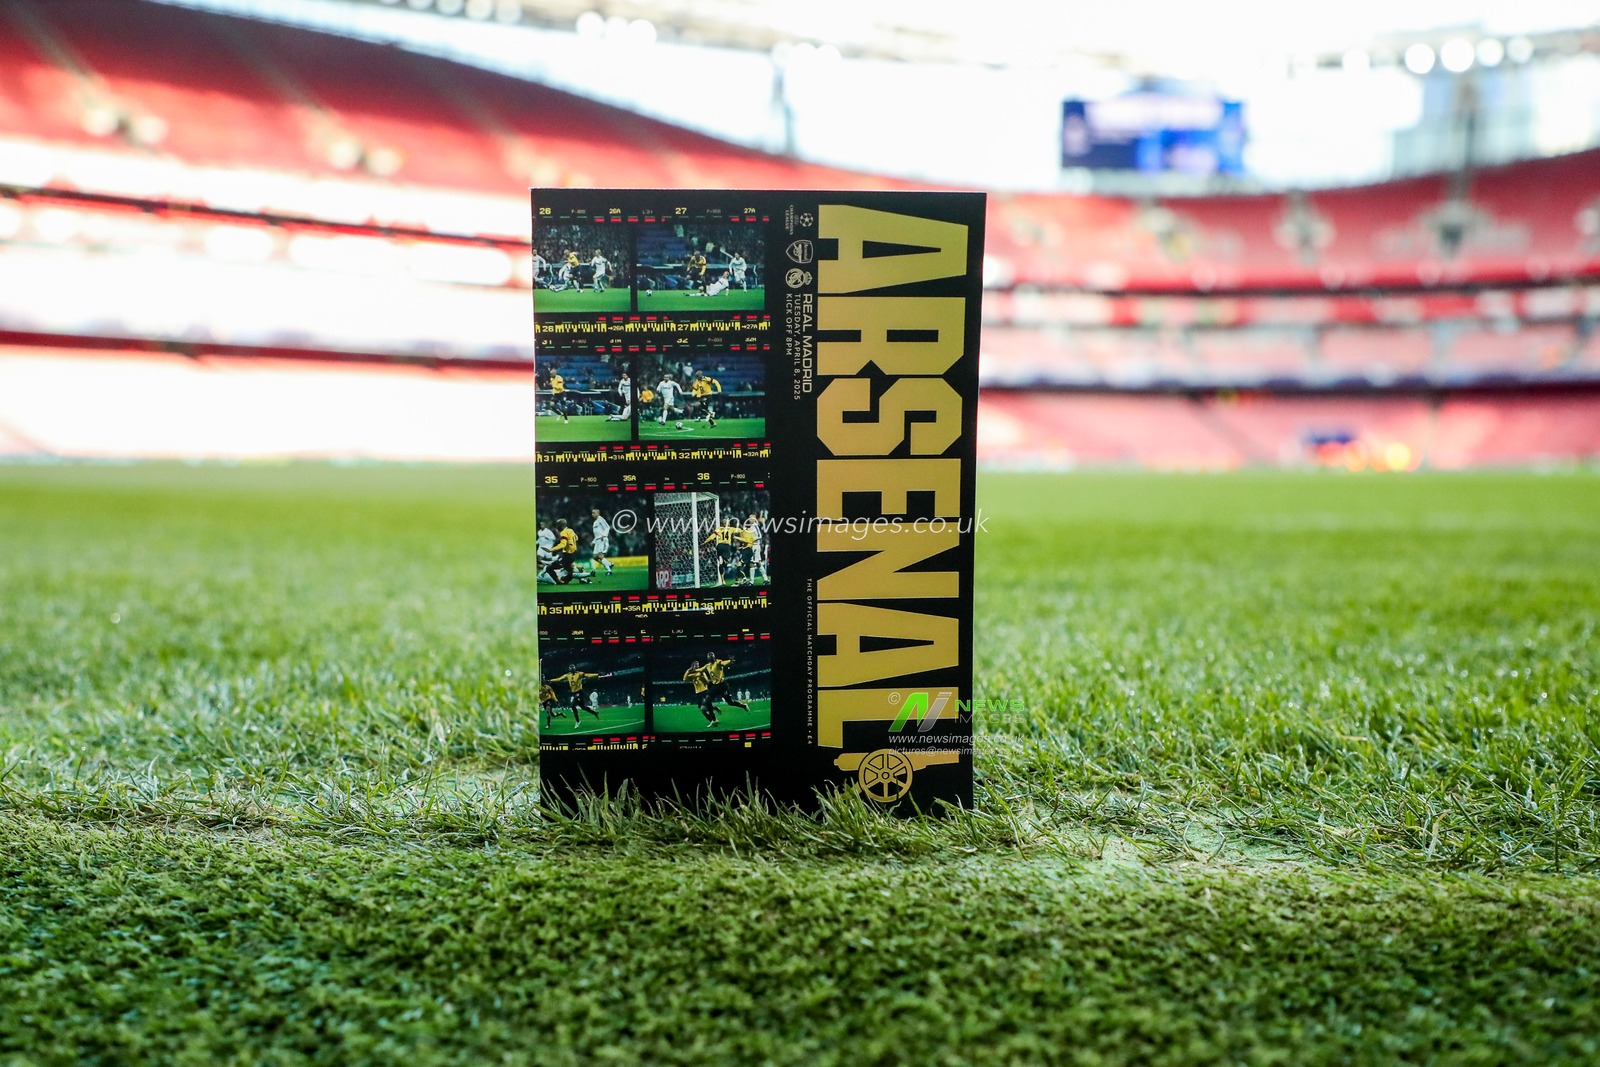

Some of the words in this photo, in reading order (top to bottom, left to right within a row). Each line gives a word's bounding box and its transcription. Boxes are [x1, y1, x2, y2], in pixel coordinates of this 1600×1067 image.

[802, 294, 812, 332] REAL
[802, 335, 812, 392] MADRID
[817, 204, 968, 748] ARSENAL
[722, 532, 729, 540] 14
